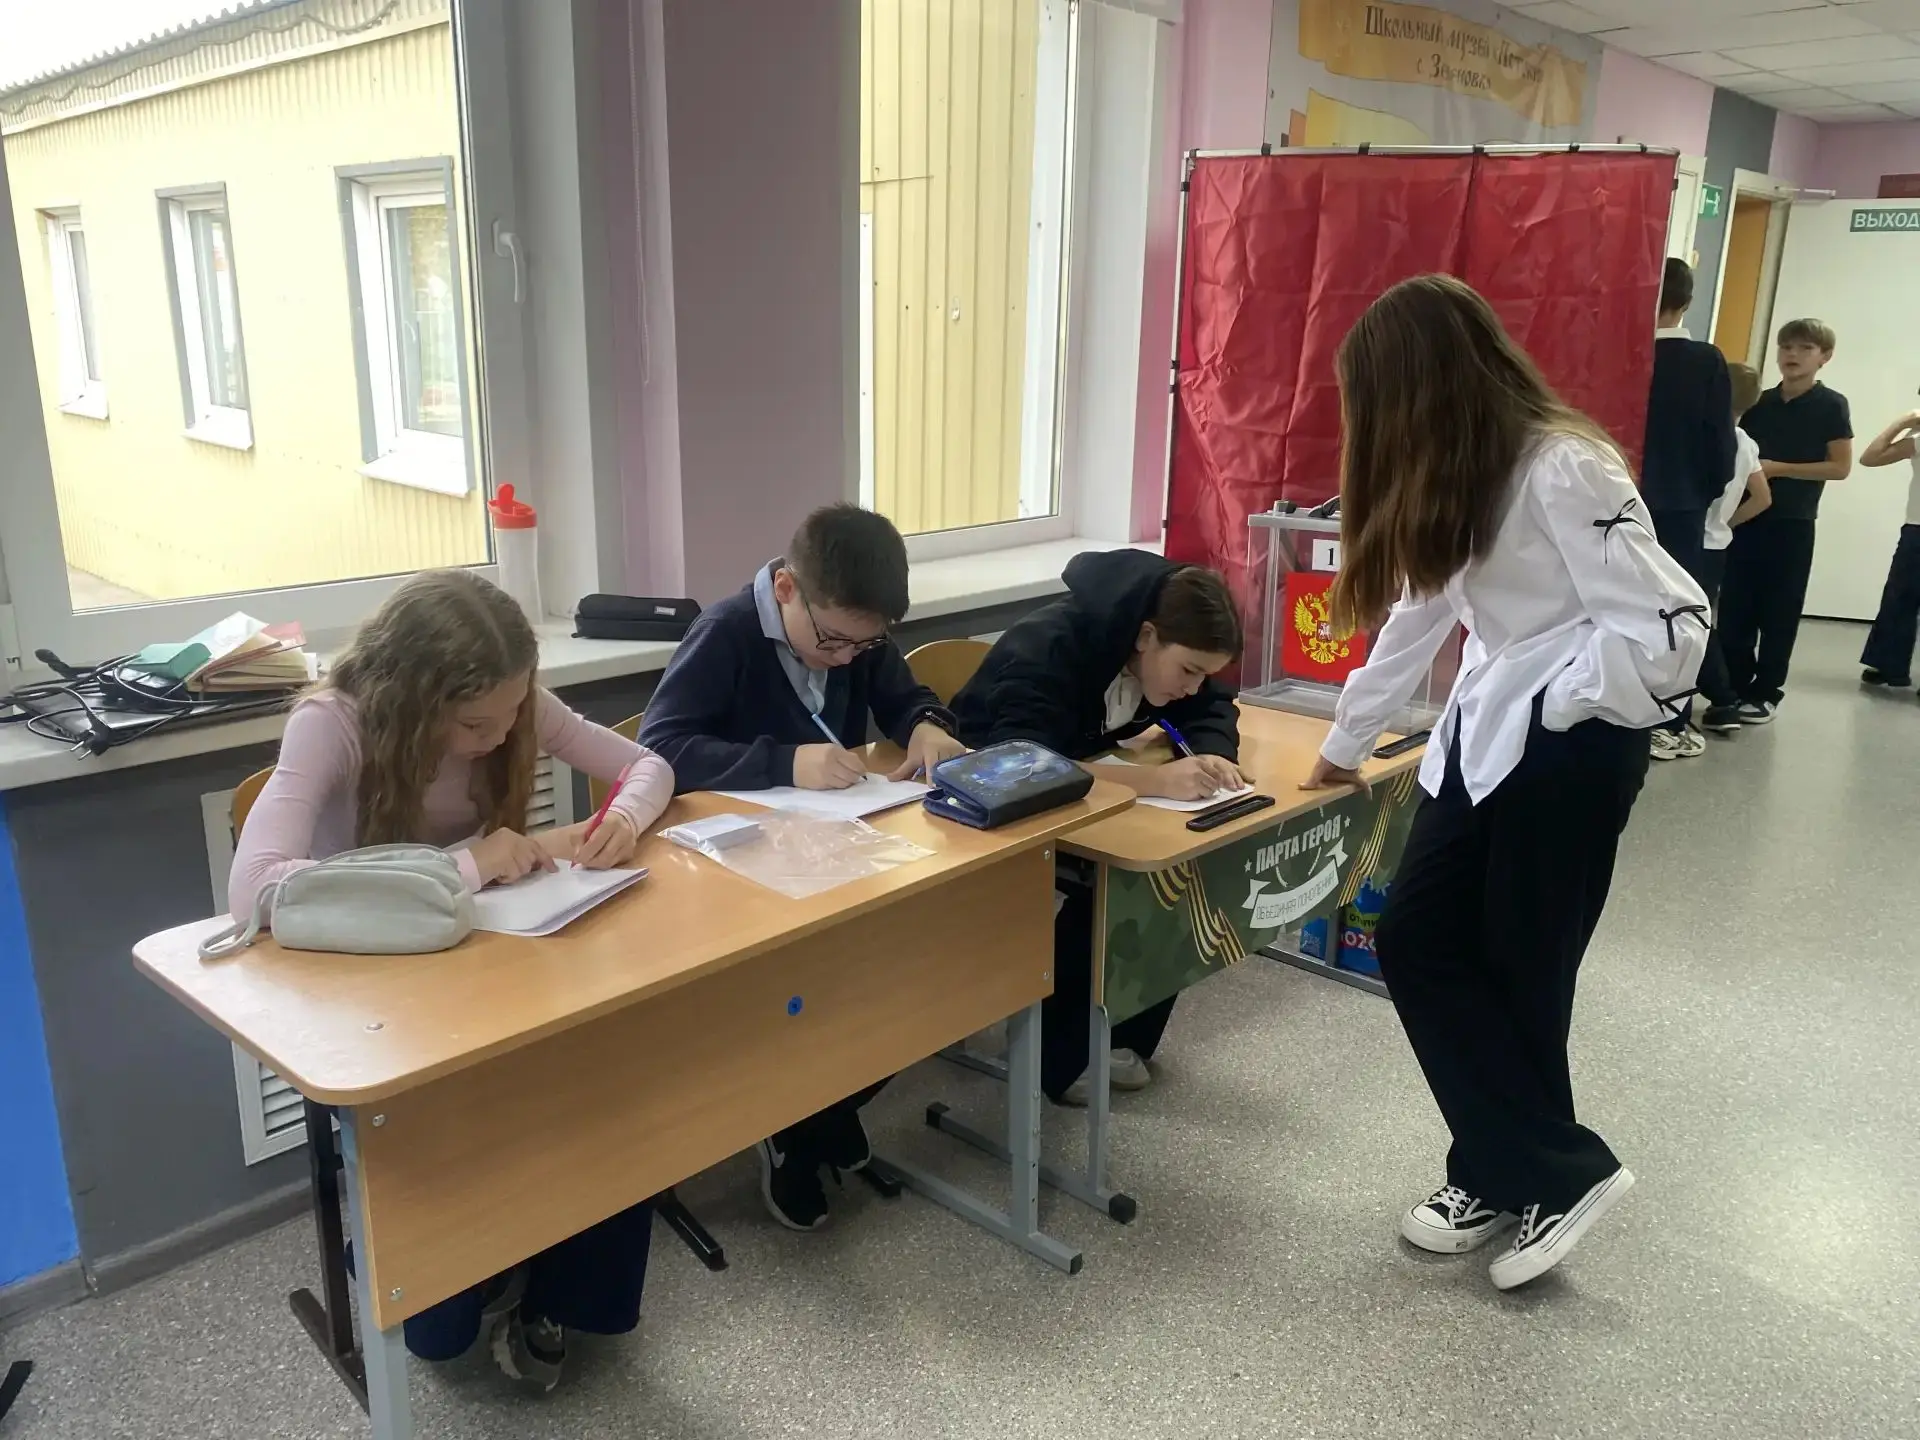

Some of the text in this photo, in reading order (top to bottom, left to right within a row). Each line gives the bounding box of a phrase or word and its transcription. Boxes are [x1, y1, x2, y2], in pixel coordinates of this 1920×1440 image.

[1364, 5, 1443, 45] Школьный
[1854, 212, 1919, 228] ВЫХОД
[1256, 814, 1341, 874] ПАРТА ГЕРОЯ
